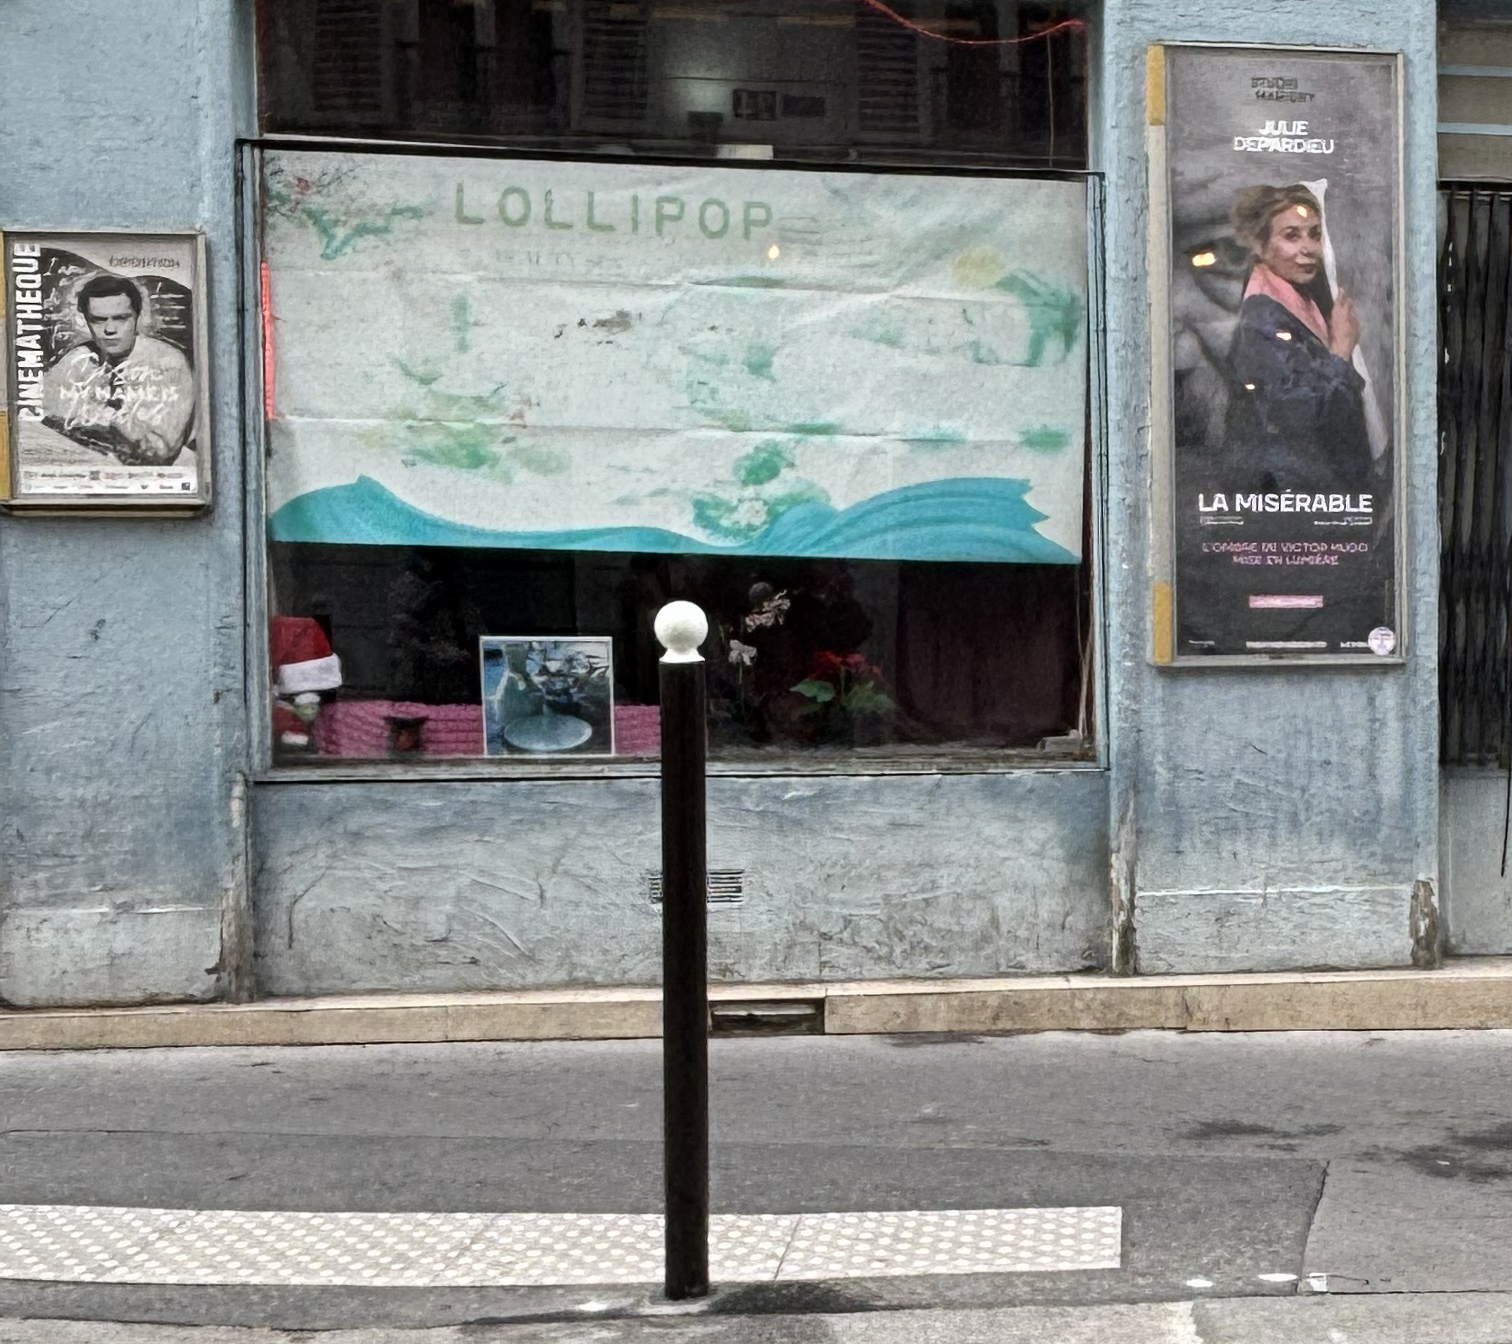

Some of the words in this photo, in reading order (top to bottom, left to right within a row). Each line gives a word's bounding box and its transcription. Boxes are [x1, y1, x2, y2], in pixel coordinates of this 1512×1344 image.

[1257, 119, 1309, 136] JULIE
[1232, 136, 1335, 155] DEPARDIEU
[454, 181, 774, 241] LOLLIPOP
[1198, 493, 1229, 513] LA
[1235, 488, 1374, 514] MISÉRABLE
